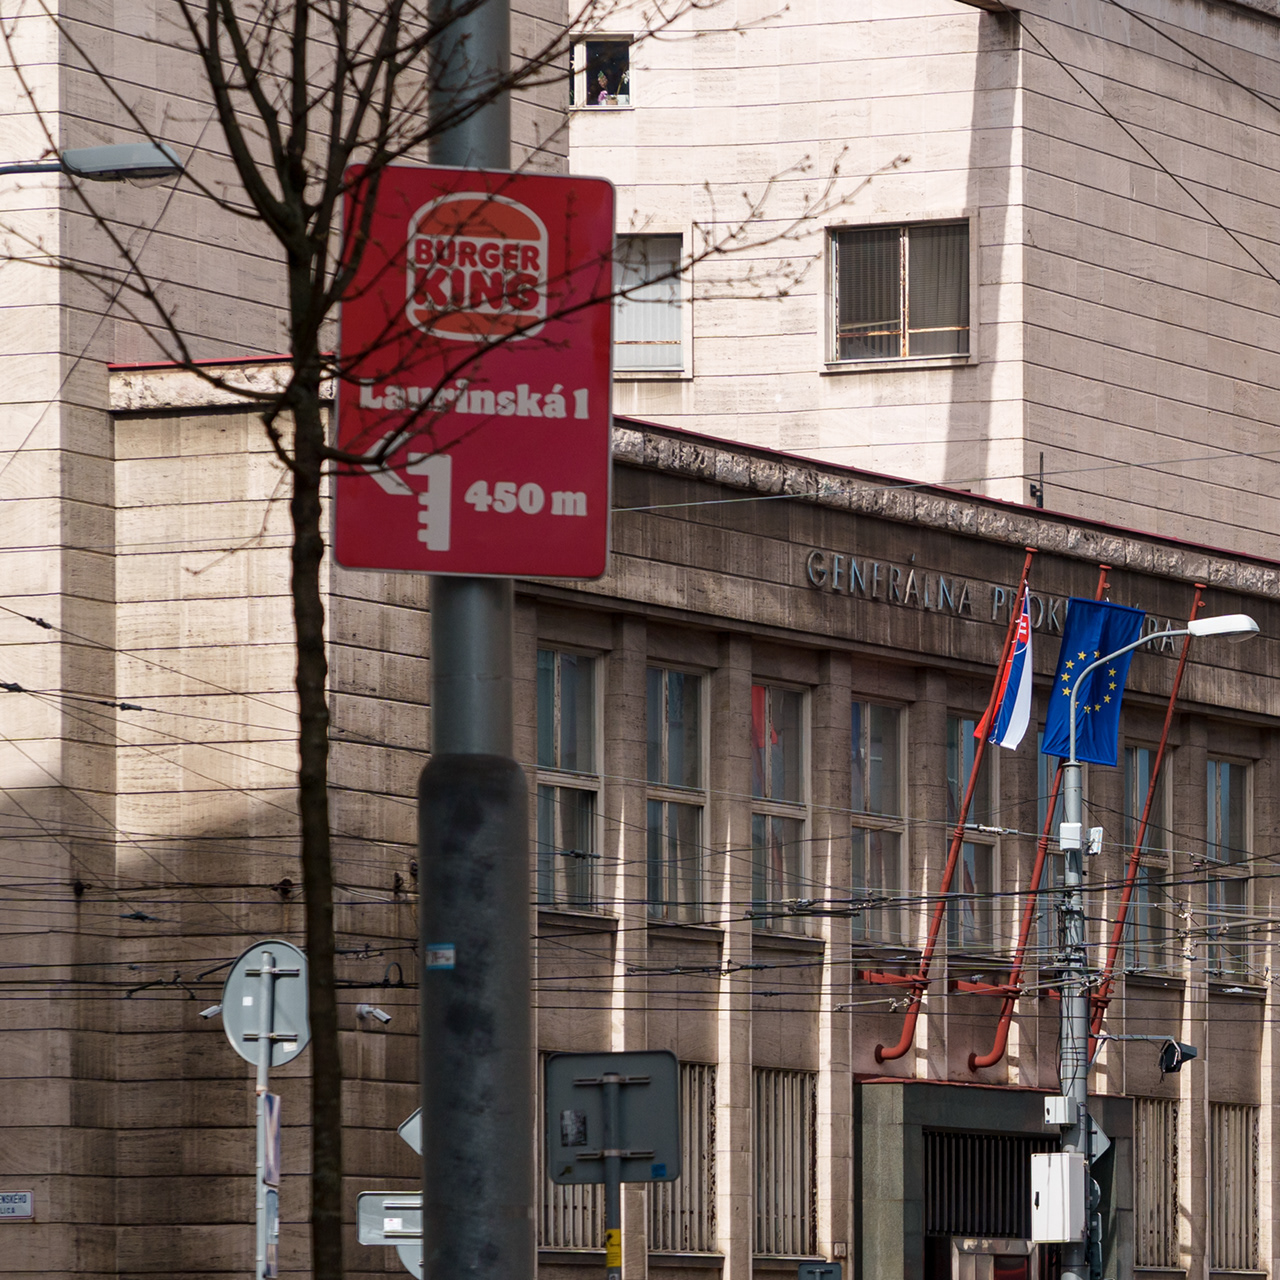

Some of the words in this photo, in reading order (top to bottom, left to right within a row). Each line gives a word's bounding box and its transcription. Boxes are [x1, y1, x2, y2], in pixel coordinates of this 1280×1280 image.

[414, 238, 541, 273] BURGER
[413, 267, 539, 312] KING
[360, 378, 567, 419] Laurinská
[574, 387, 590, 420] 1
[464, 480, 544, 515] 450
[551, 490, 588, 517] m
[806, 549, 972, 616] GENERÁLNA
